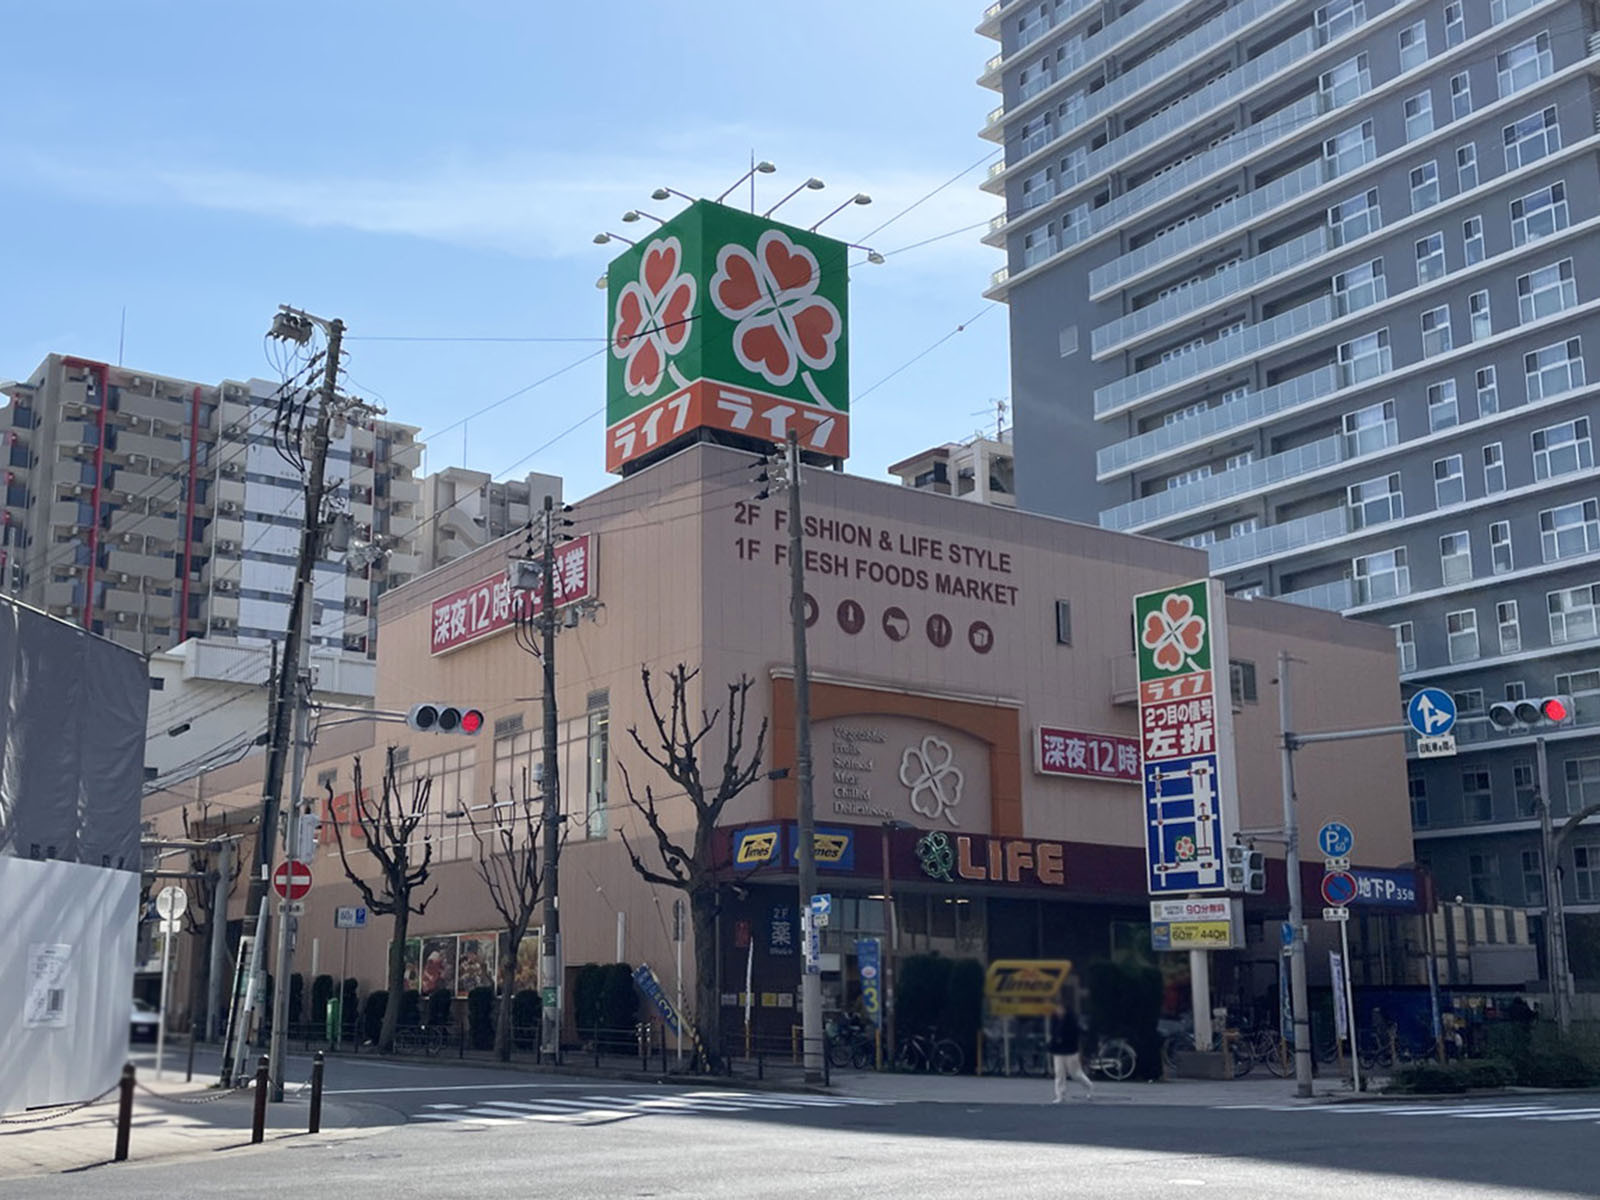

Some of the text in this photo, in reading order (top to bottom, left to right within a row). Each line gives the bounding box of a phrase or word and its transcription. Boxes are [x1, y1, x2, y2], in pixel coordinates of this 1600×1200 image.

[614, 392, 691, 458] ライフ
[717, 390, 835, 448] ライフ
[734, 502, 1011, 573] 2F FSHION & LIFE STYLE
[735, 538, 1018, 606] 1F FESH FOODS MARKET
[1148, 675, 1204, 700] ライフ
[1146, 699, 1212, 728] 2つ目の信号
[1044, 735, 1142, 776] 深夜12時
[1146, 720, 1212, 758] 左折
[744, 841, 769, 859] Times
[957, 837, 1064, 884] LIFE
[1327, 831, 1340, 852] P
[995, 969, 1054, 993] Times
